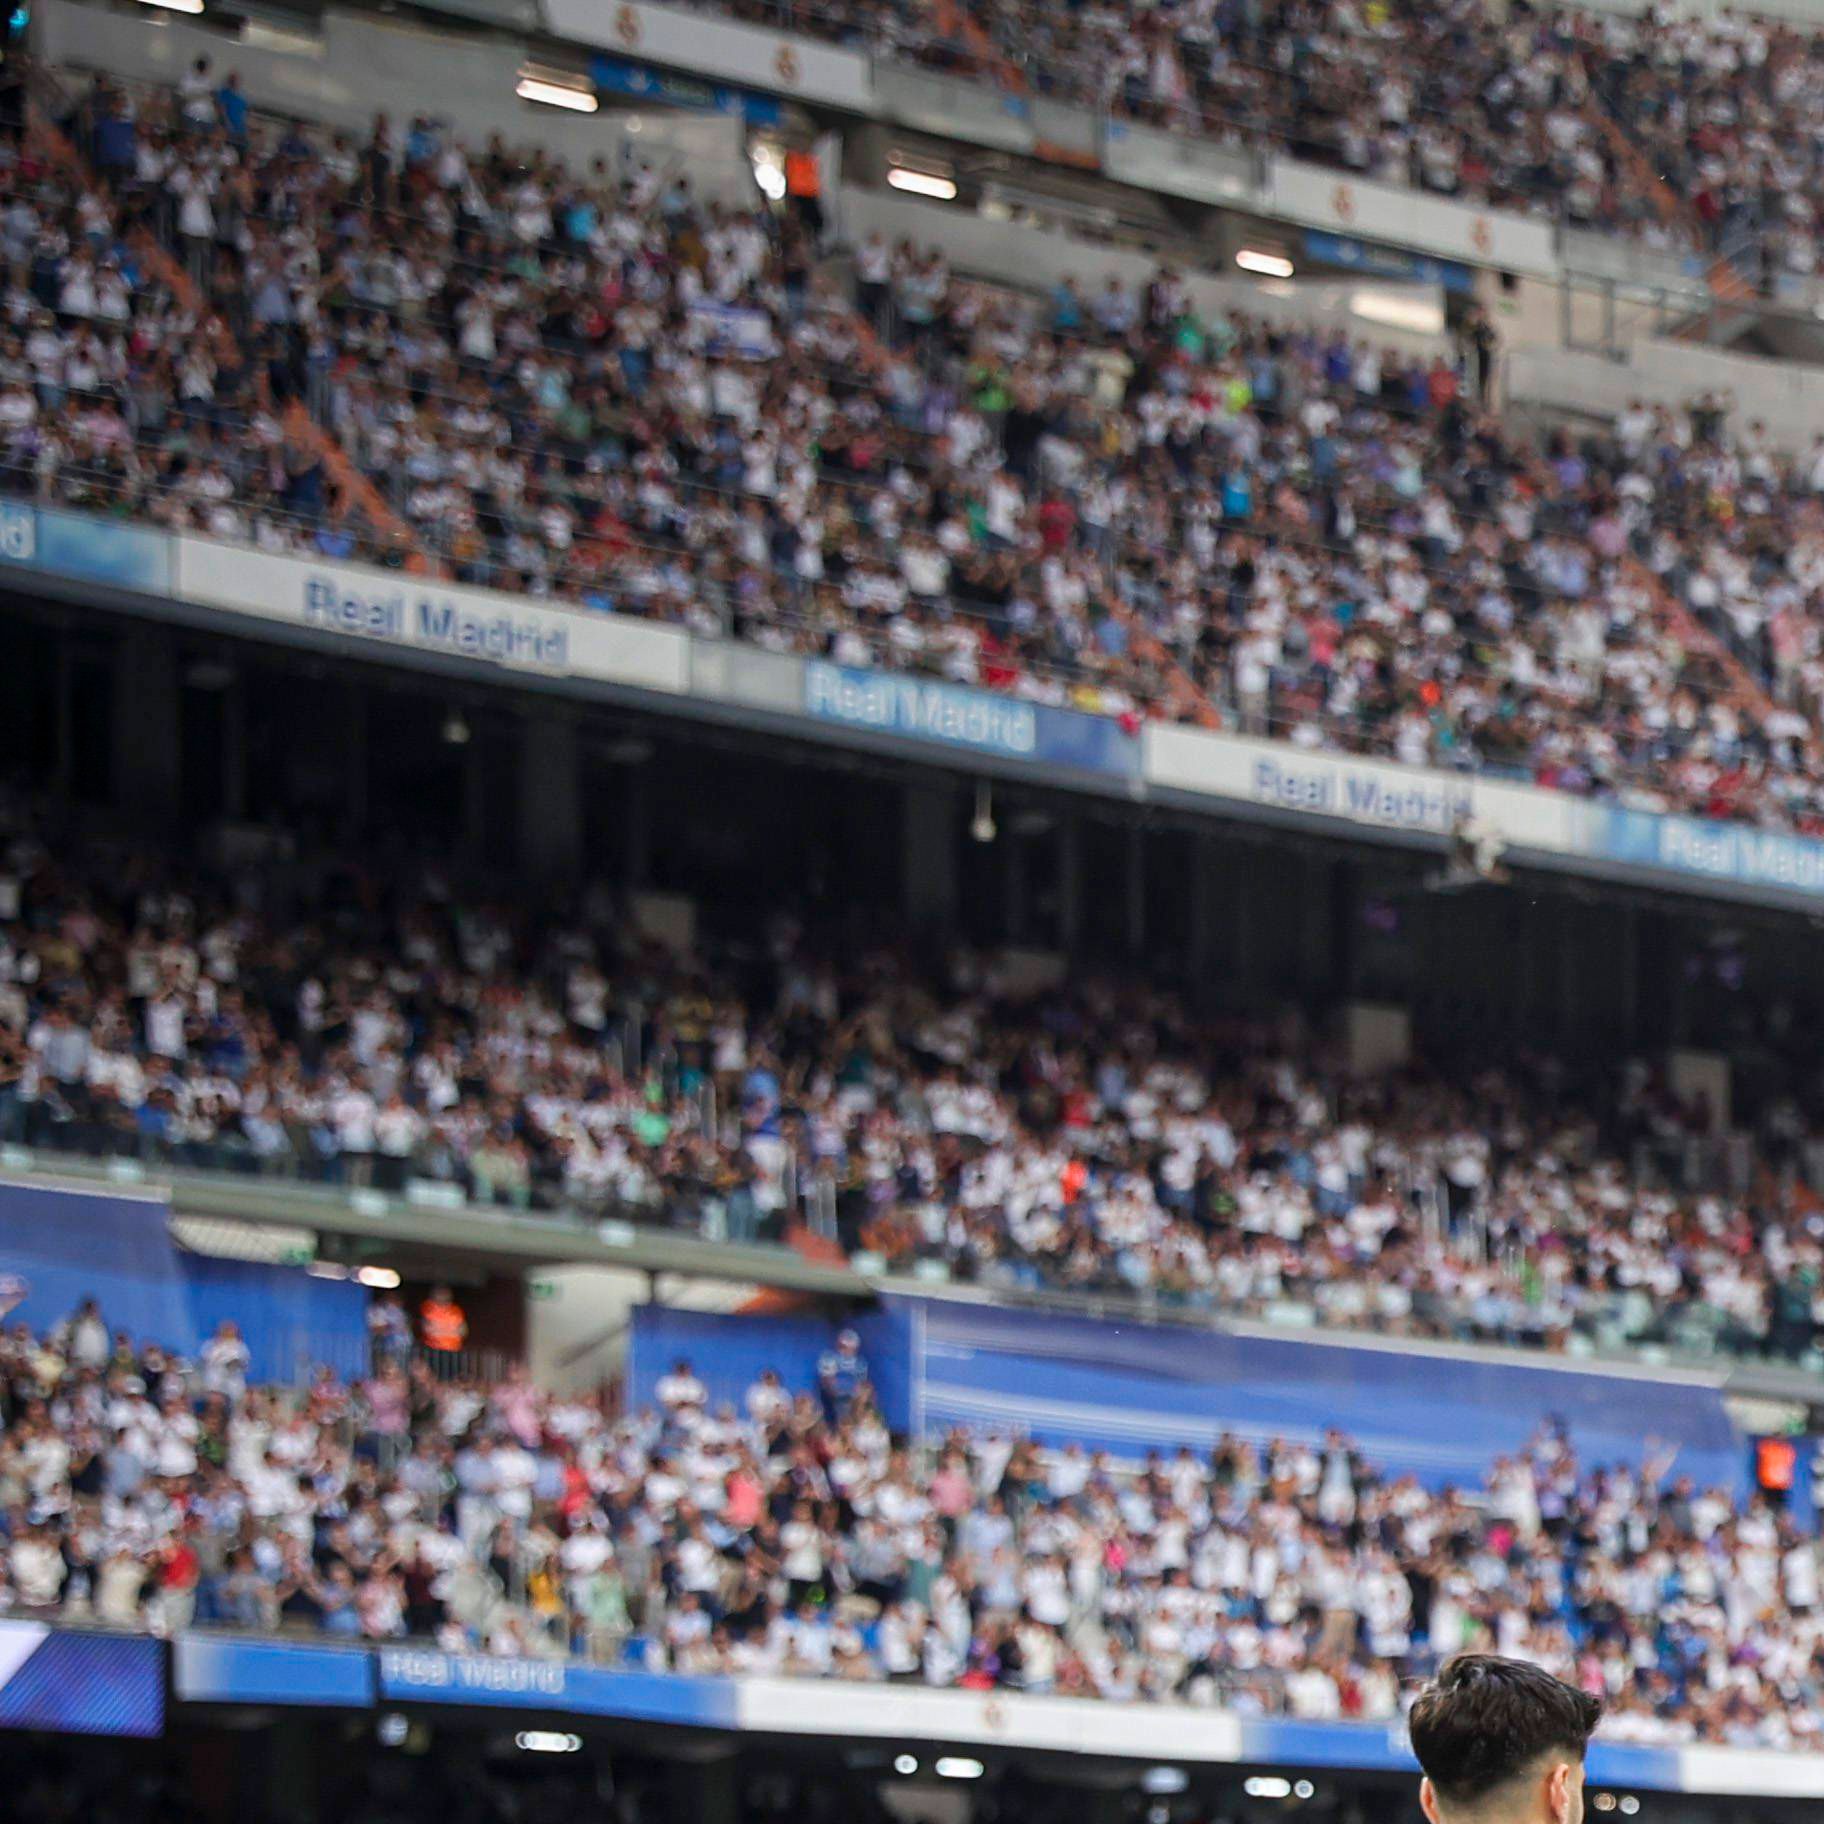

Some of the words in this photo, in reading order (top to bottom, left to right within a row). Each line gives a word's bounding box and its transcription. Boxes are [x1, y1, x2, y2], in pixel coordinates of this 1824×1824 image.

[304, 576, 399, 638] Real
[417, 602, 569, 664] Madrid
[812, 666, 892, 728] Real
[904, 685, 1035, 752] Madrid
[1252, 758, 1332, 806] Real
[1661, 824, 1728, 872] Real
